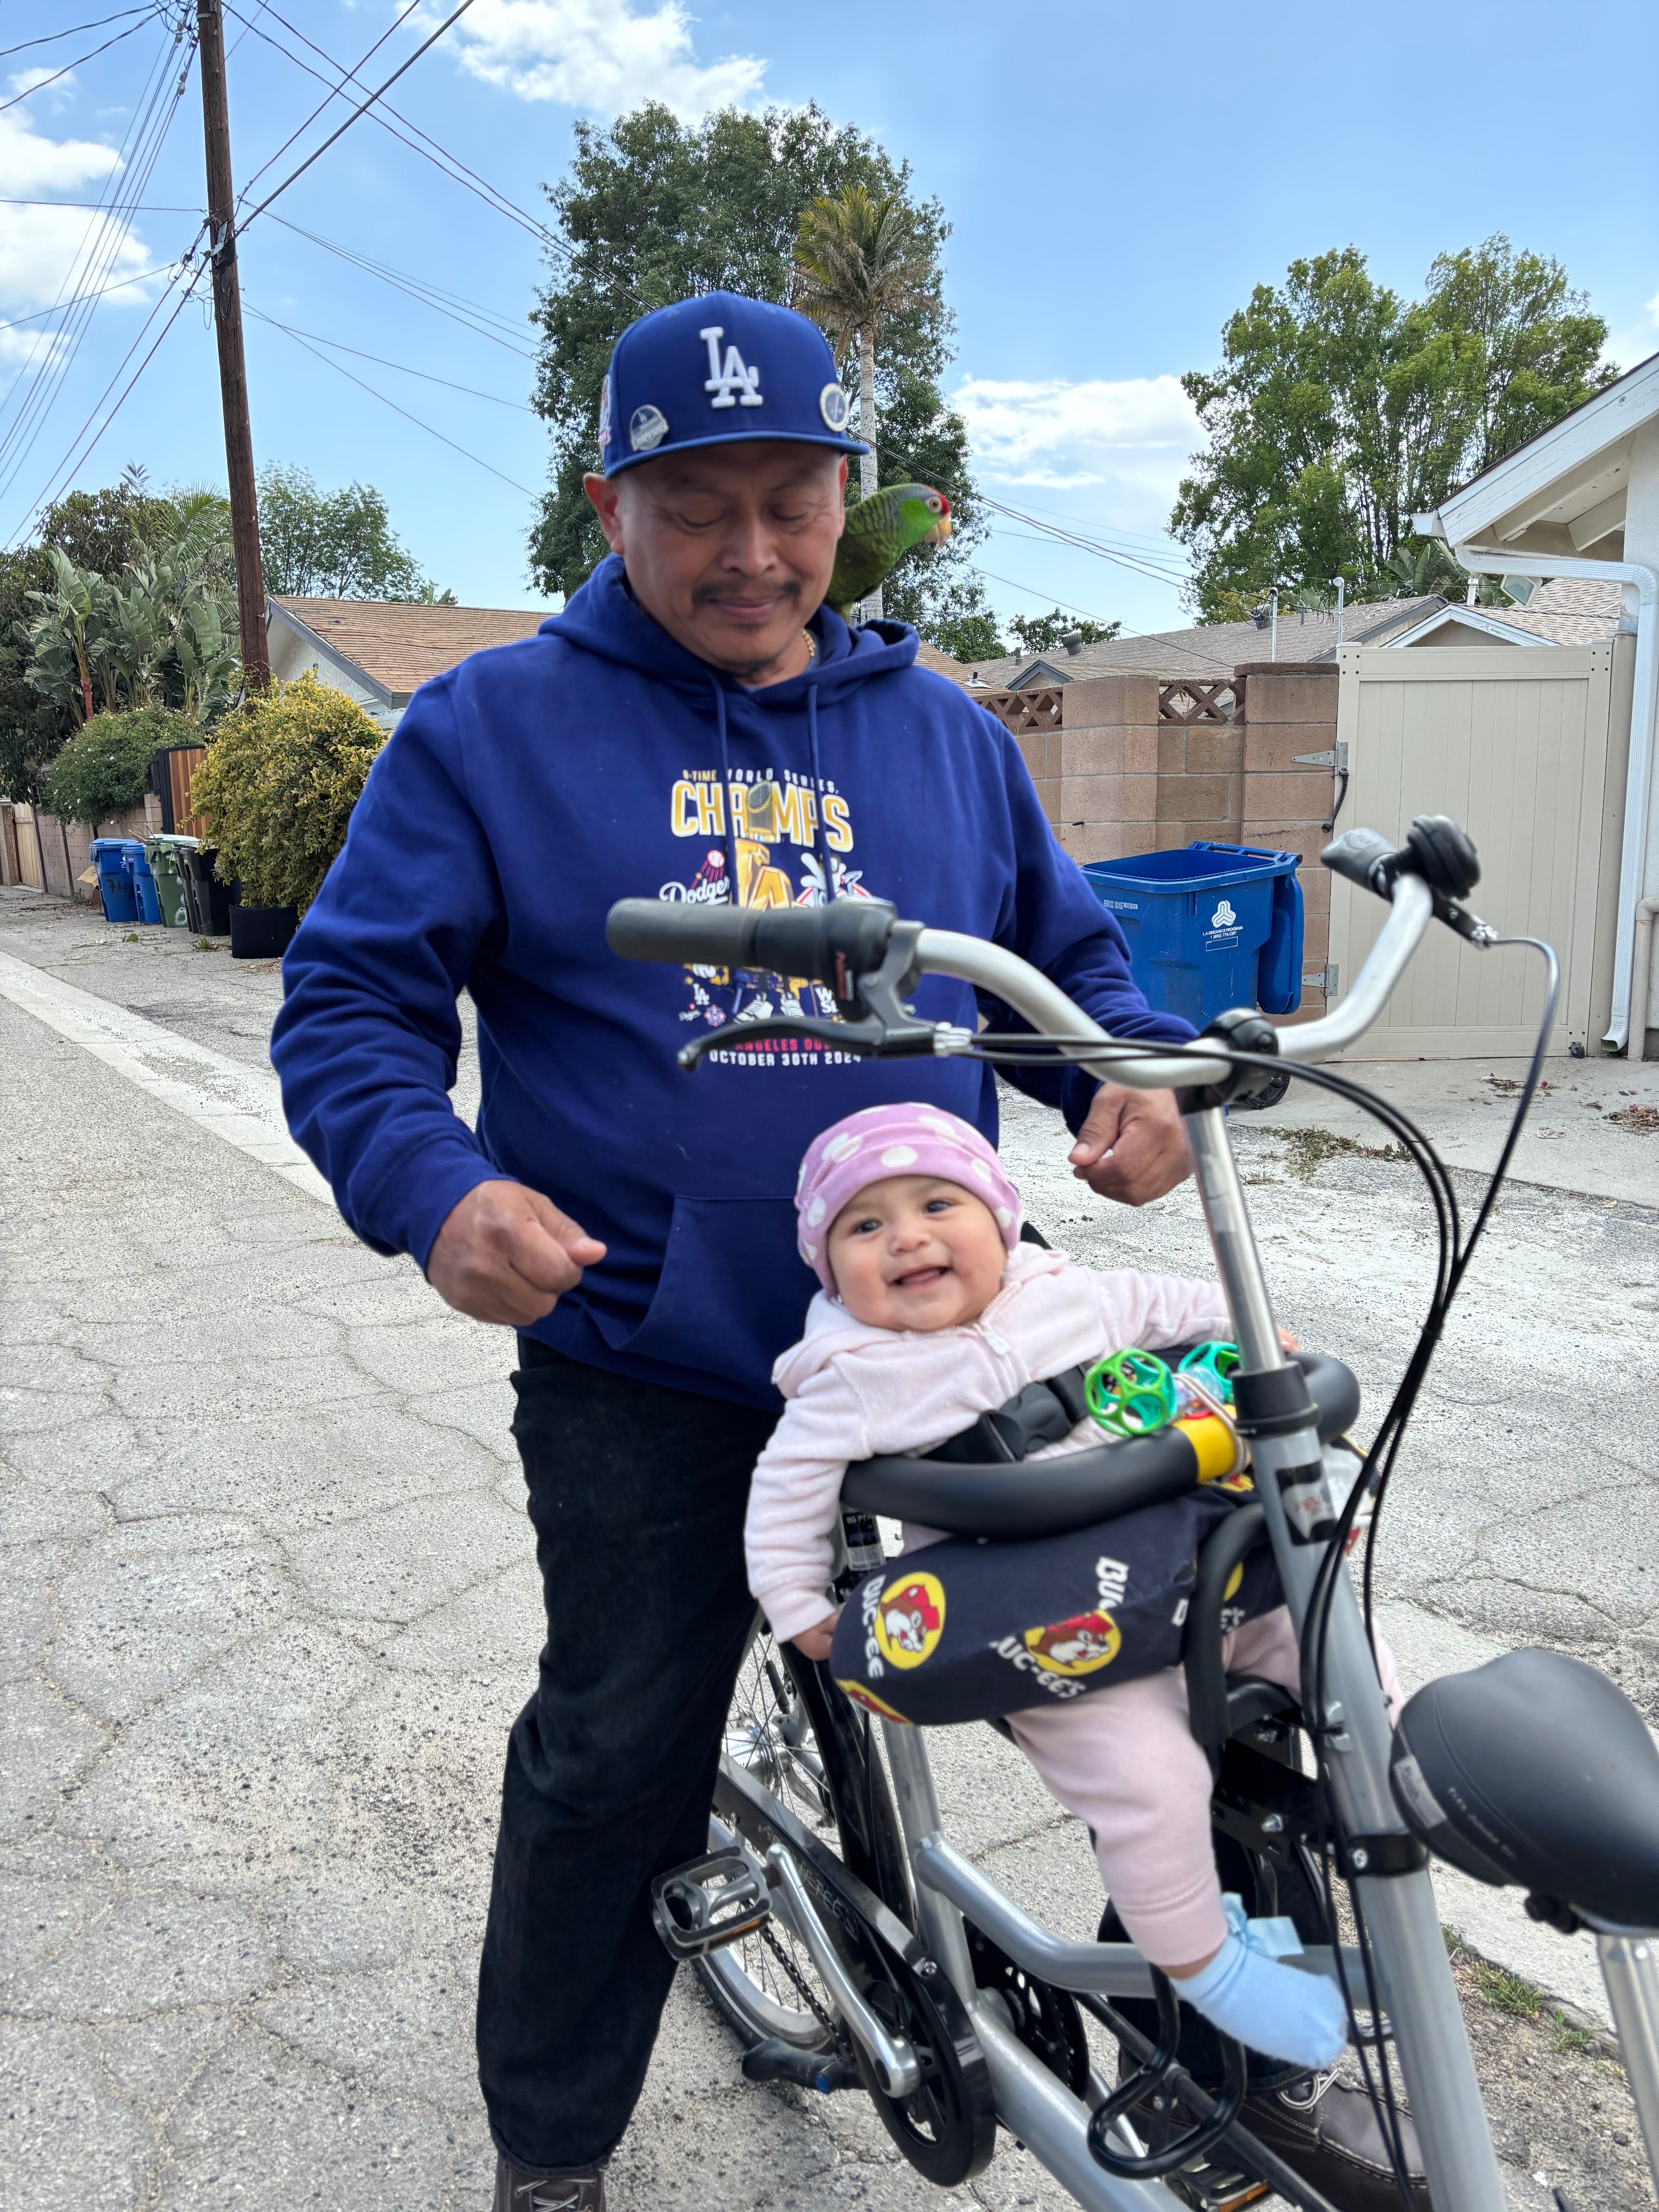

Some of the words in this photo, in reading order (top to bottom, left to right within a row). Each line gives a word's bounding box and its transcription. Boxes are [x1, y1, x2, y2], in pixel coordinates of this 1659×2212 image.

[700, 327, 763, 409] LA
[671, 780, 853, 852] CHAMPS
[659, 876, 730, 905] Dodger
[693, 983, 709, 1005] LA
[709, 1049, 775, 1066] OCTOBER
[781, 1053, 818, 1066] 30TH
[988, 1636, 1087, 1698] UC-EE'S
